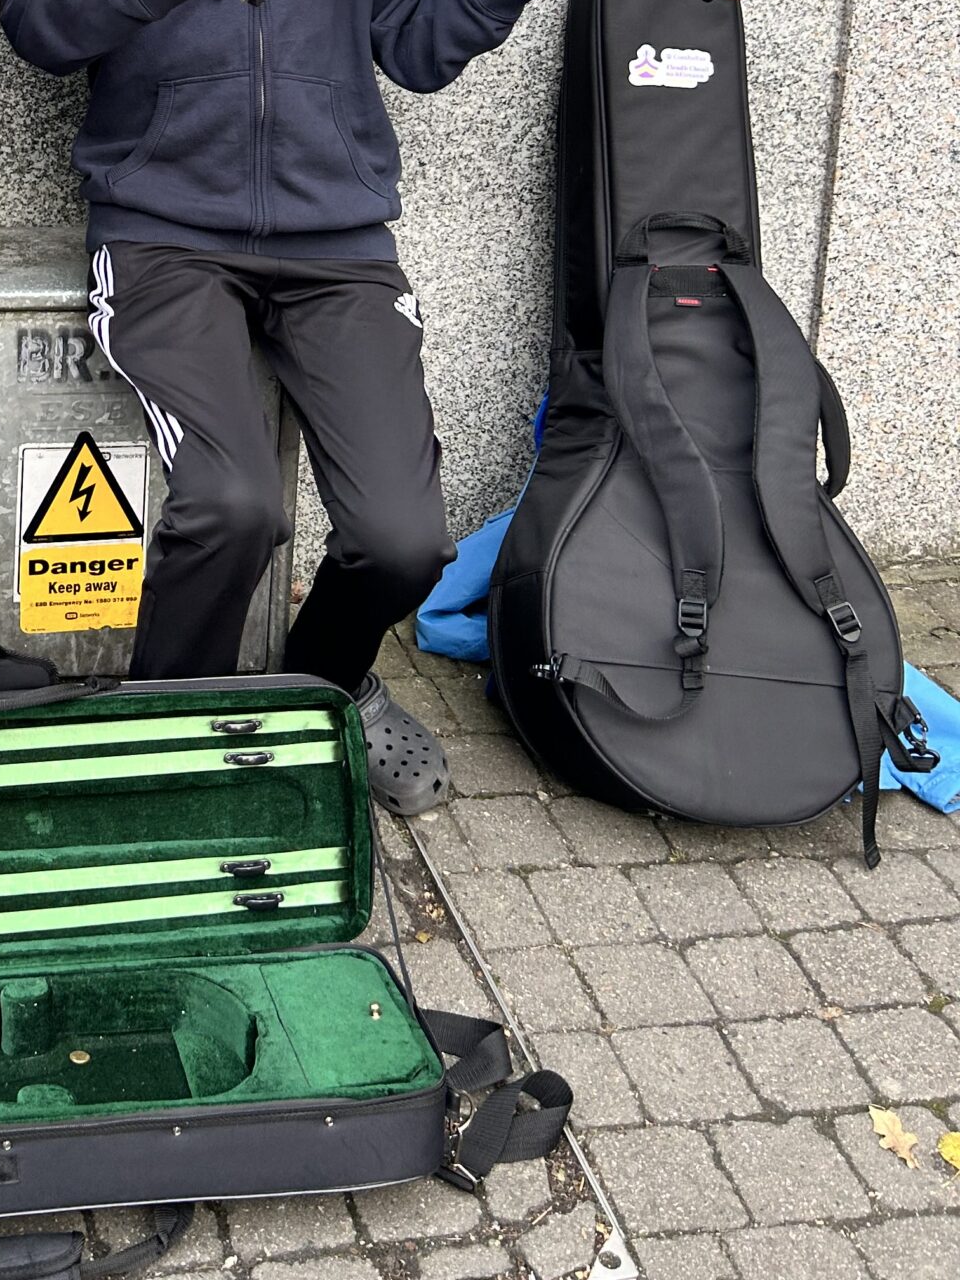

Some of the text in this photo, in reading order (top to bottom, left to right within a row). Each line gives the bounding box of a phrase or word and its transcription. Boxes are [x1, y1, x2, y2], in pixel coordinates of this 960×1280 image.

[28, 557, 139, 576] Danger
[48, 580, 118, 595] Keep away
[49, 599, 82, 607] Emergency
